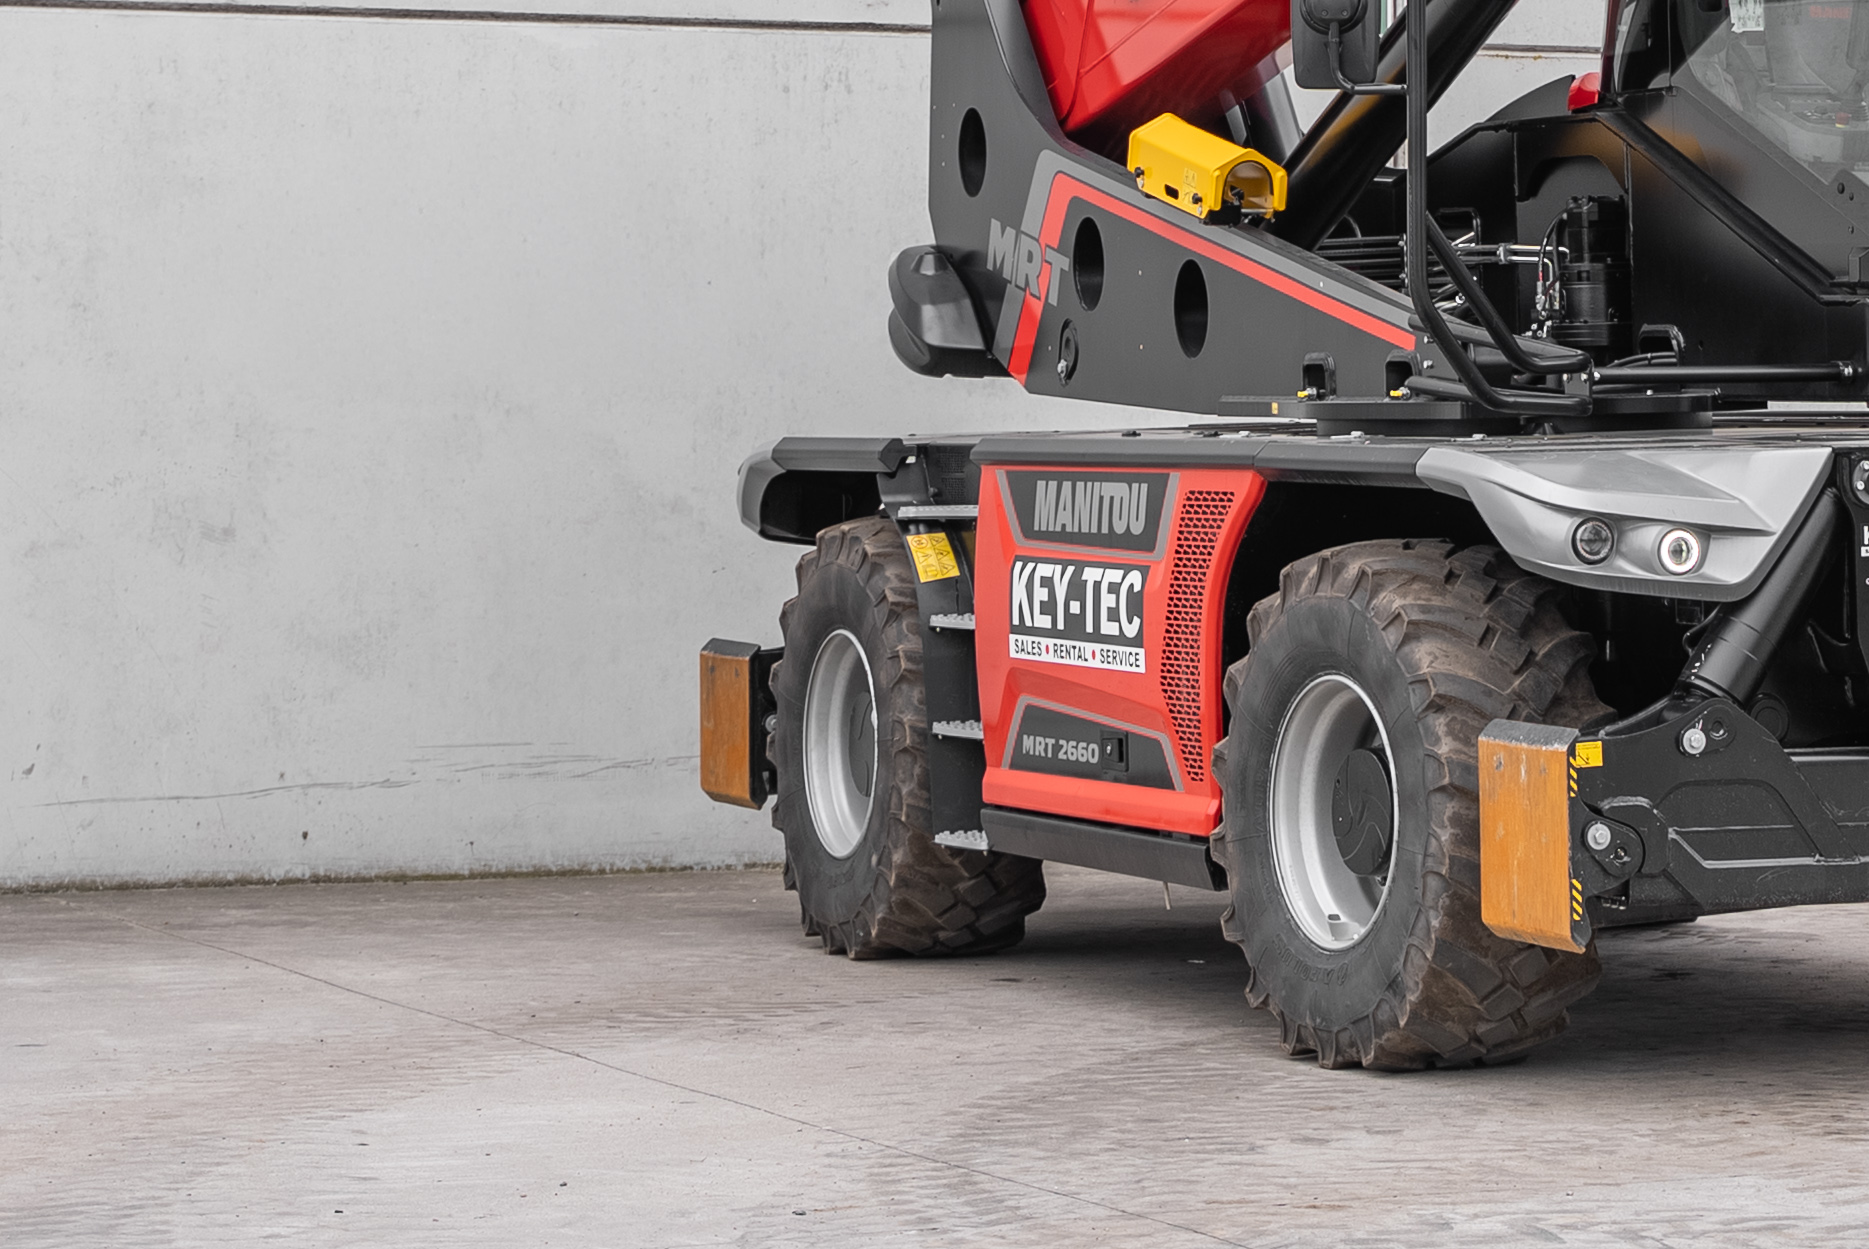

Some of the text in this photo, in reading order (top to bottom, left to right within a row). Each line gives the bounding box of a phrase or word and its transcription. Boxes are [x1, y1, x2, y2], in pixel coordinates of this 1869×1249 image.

[986, 218, 1070, 307] MRT
[1033, 480, 1148, 535] MANITOU
[1012, 560, 1142, 639] KEY-TEC
[1014, 638, 1140, 668] SALES RENTAL SERVICE
[1022, 734, 1099, 764] MRT 2660
